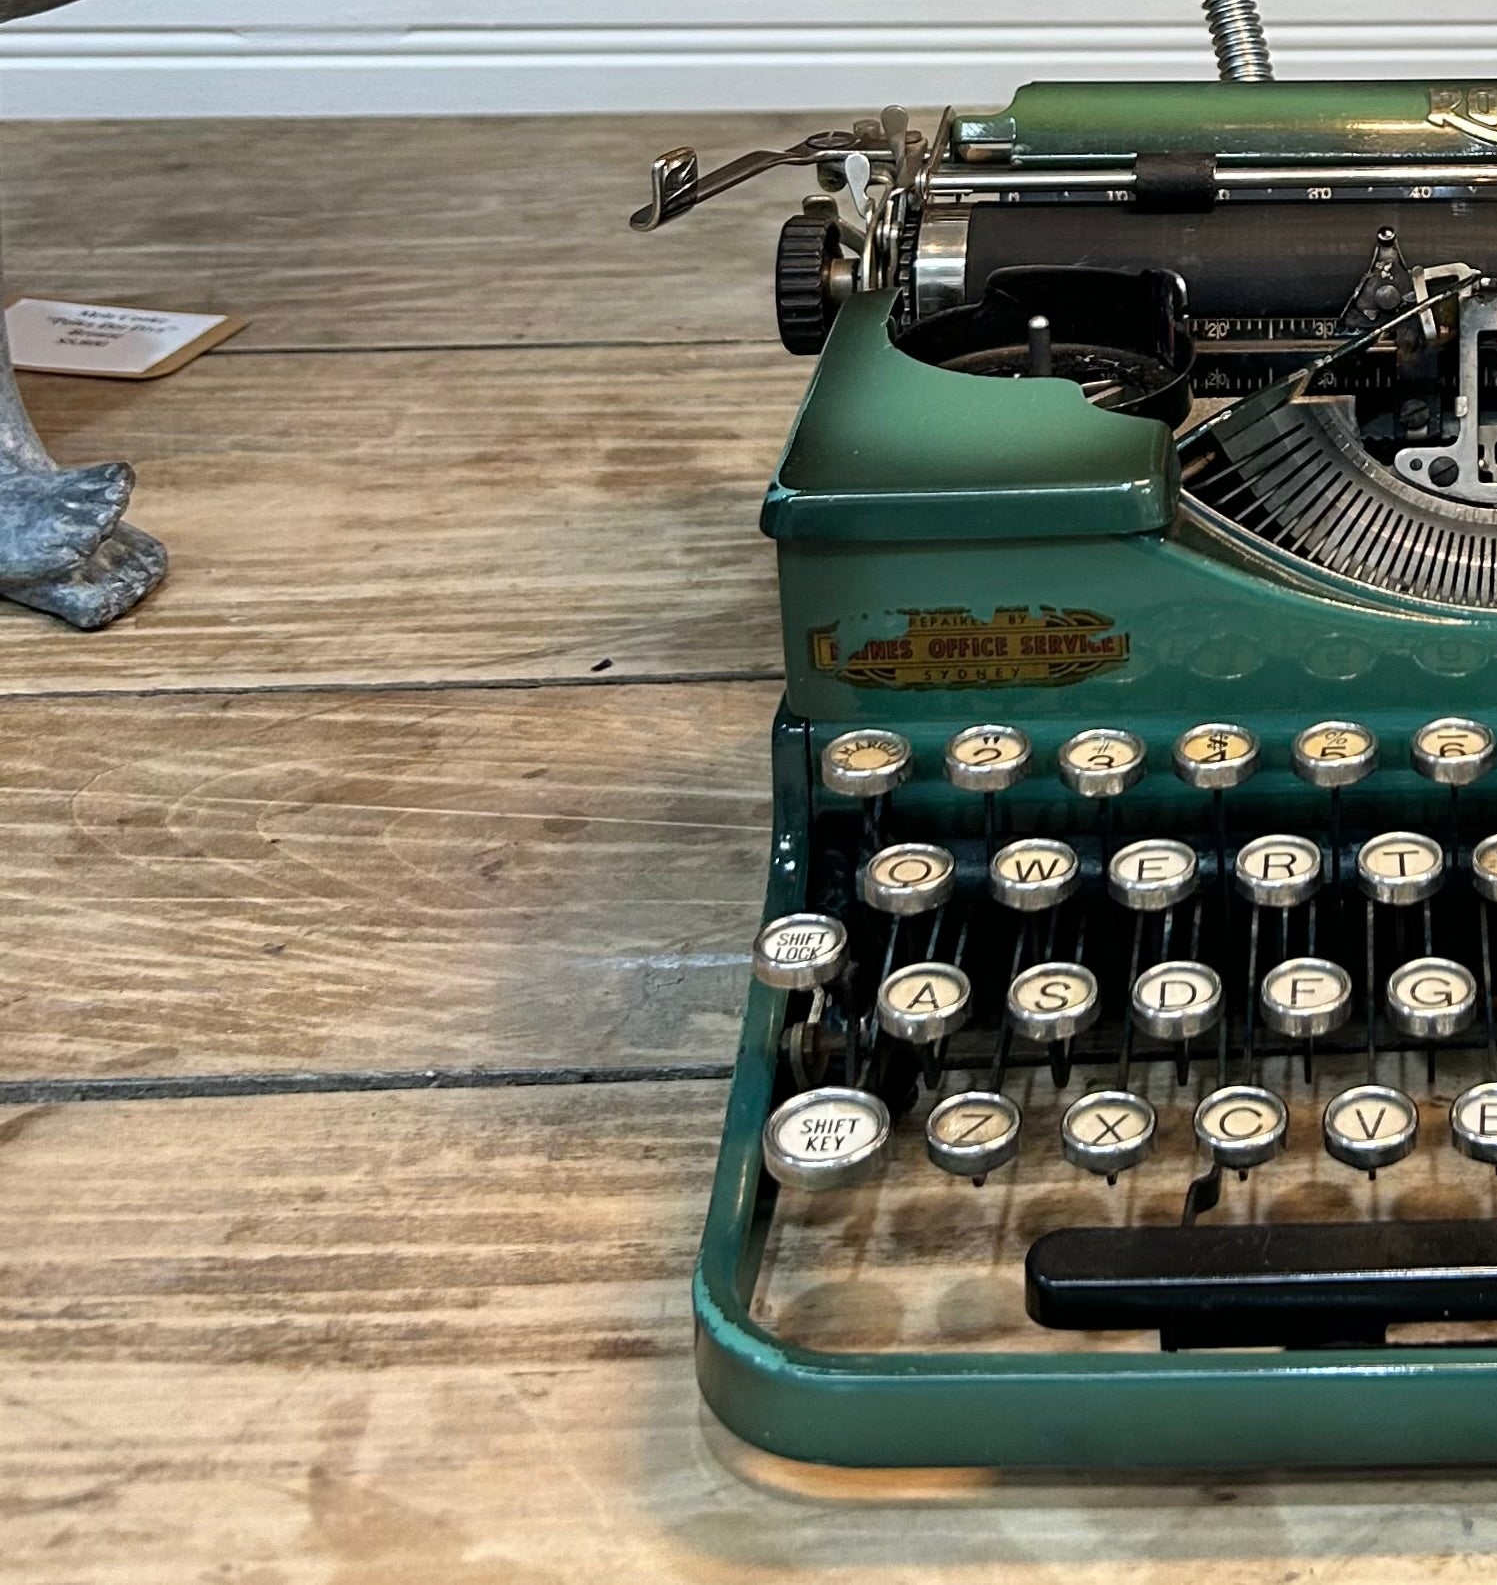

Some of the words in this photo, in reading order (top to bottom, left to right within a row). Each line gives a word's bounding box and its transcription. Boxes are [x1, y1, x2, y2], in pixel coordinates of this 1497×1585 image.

[1408, 185, 1433, 199] 40
[1206, 321, 1228, 337] 20
[1315, 320, 1335, 337] 30
[1207, 370, 1227, 386] 20
[1008, 615, 1026, 625] BY
[928, 636, 1008, 659] OFFICE
[924, 666, 1020, 682] SYDNEY
[1015, 857, 1060, 882] W
[1136, 855, 1170, 881] E
[1261, 852, 1297, 879] R
[1382, 849, 1420, 877] T
[776, 930, 830, 947] SHIFT
[775, 945, 823, 961] LOCK
[906, 981, 939, 1010] A
[1035, 981, 1072, 1011] S
[1159, 979, 1197, 1009] D
[1290, 976, 1324, 1005] F
[1410, 976, 1453, 1006] G
[801, 1117, 861, 1135] SHIFT
[1092, 1113, 1131, 1144] X
[1219, 1106, 1263, 1139] C
[1355, 1106, 1387, 1140] V
[805, 1135, 846, 1152] KEY
